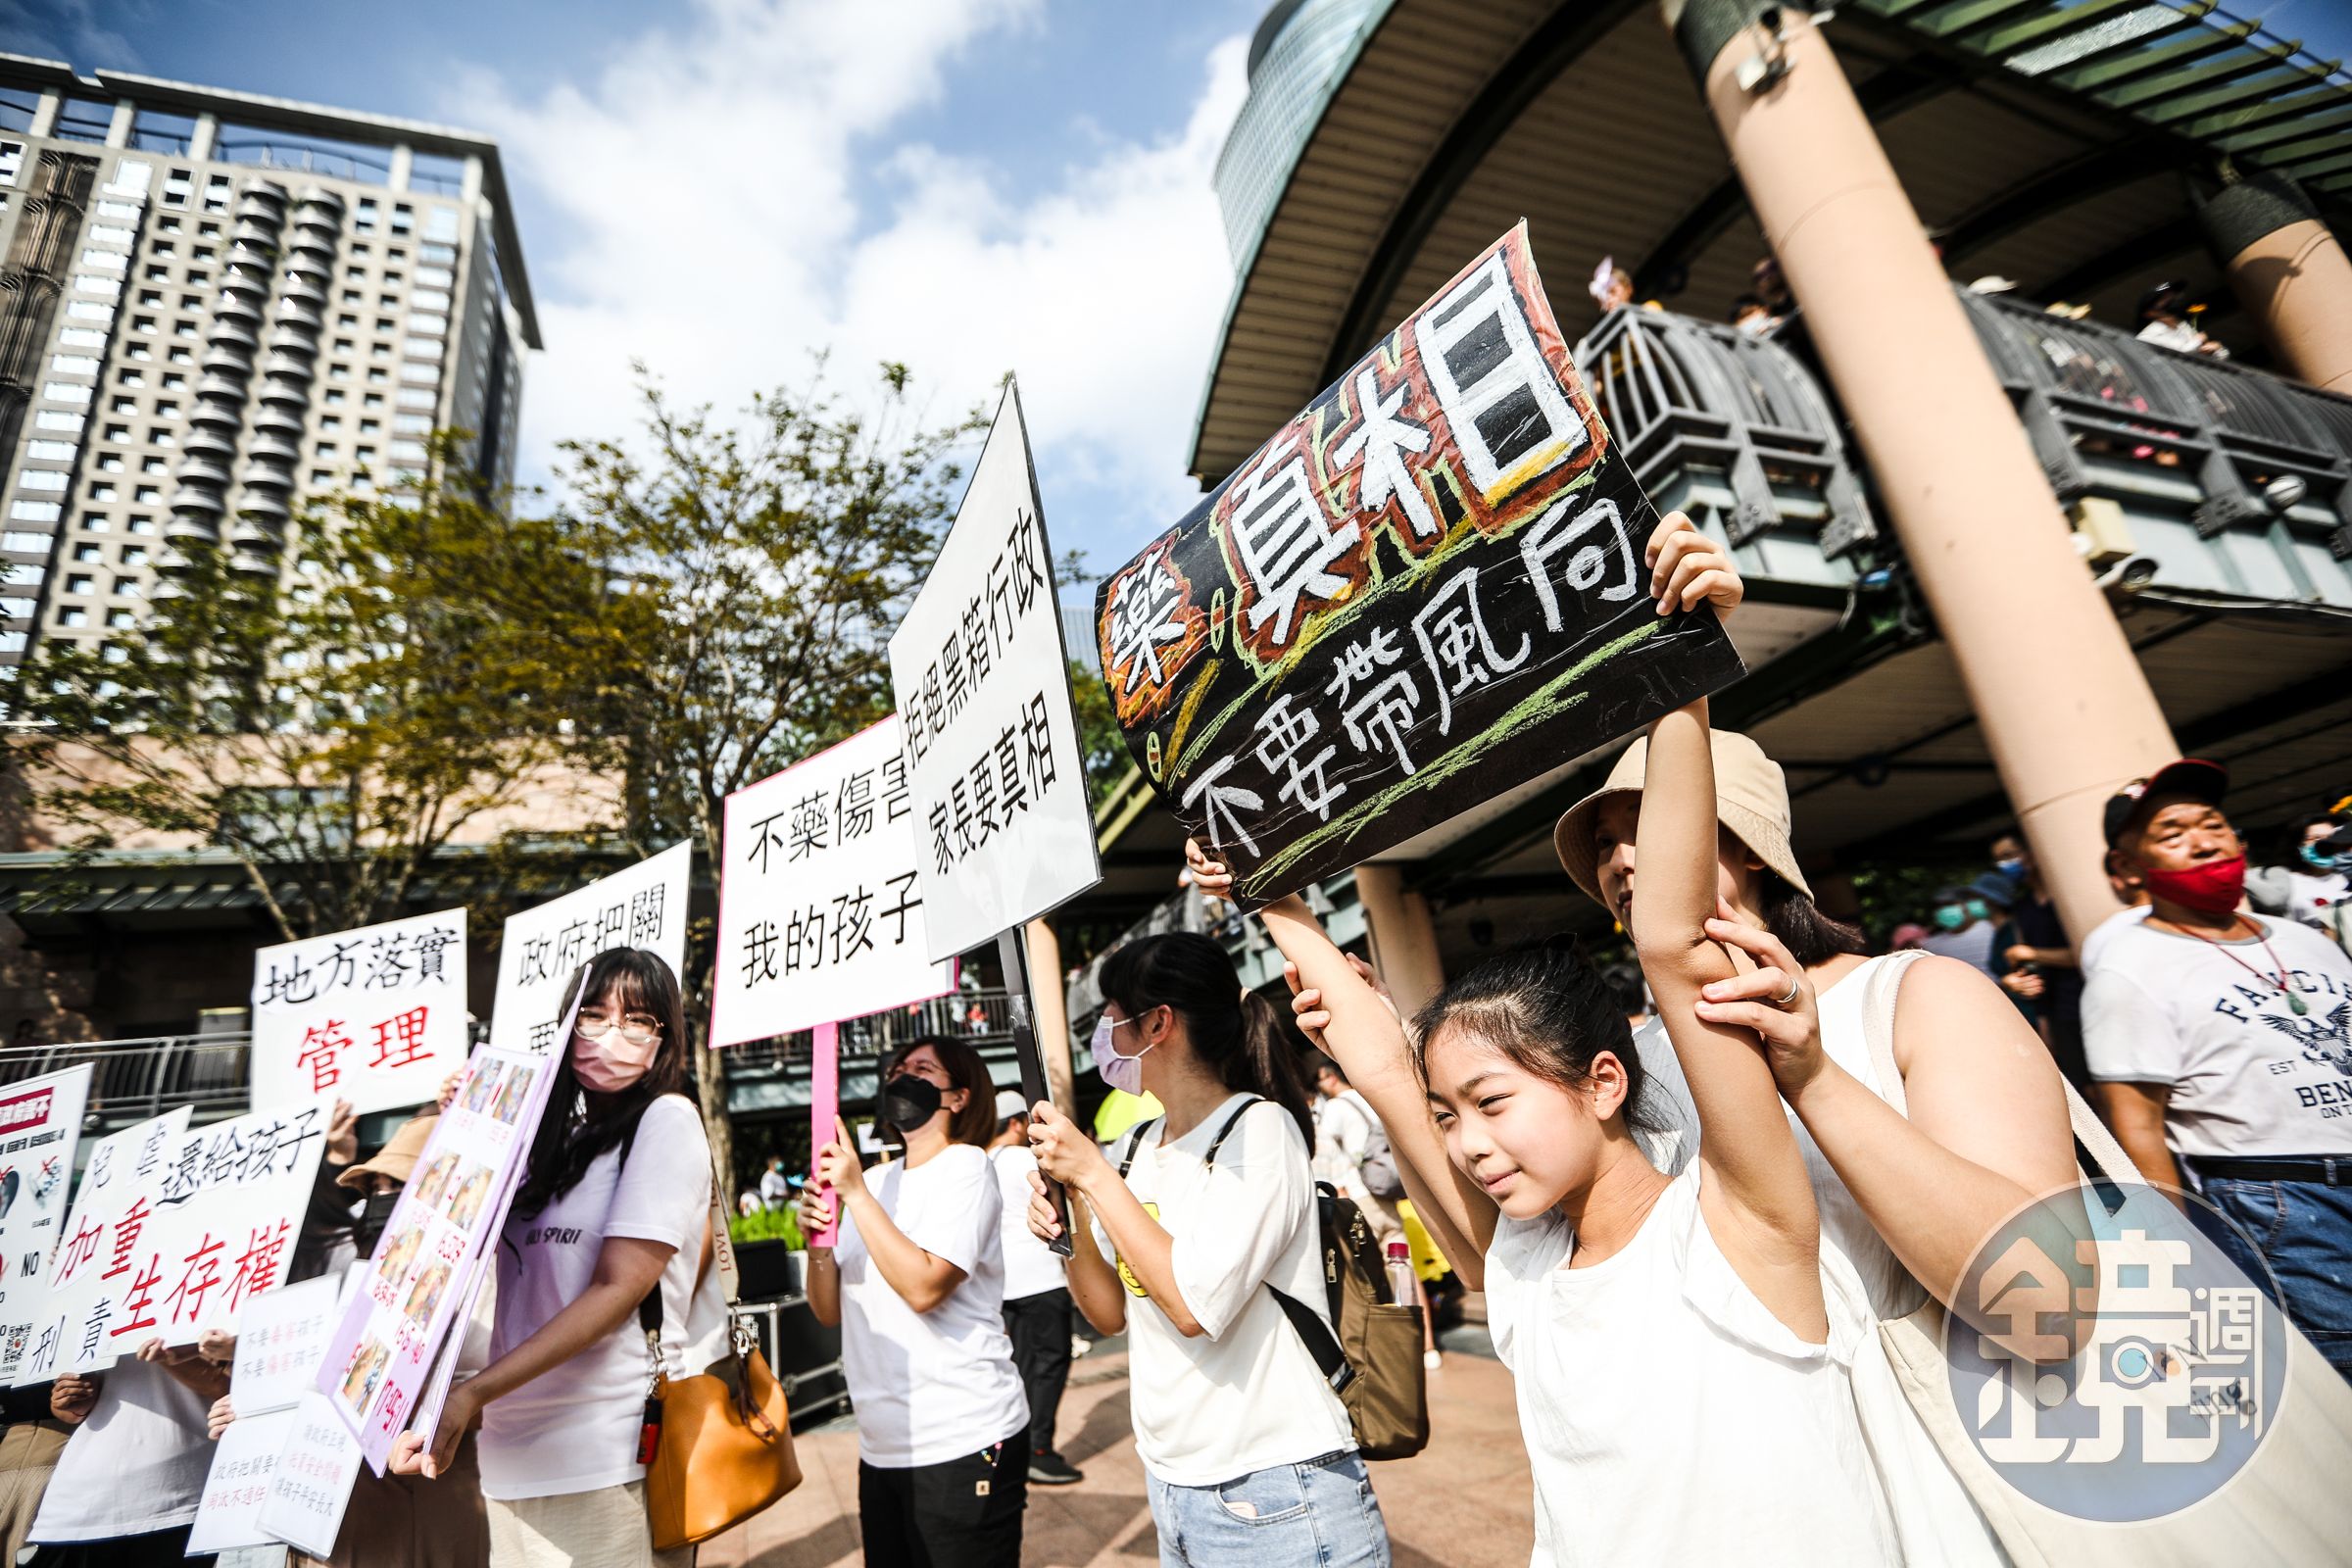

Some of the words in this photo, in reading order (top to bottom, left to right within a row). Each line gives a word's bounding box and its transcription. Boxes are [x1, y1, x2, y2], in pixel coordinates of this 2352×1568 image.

[905, 507, 1043, 769] 拒絕黑箱行政
[1183, 495, 1636, 858] 不要帶風向
[748, 748, 911, 874] 不藥傷害
[929, 690, 1055, 875] 家長要真相
[260, 927, 460, 1005] 地方落實
[517, 882, 664, 986] 政府把關
[742, 869, 922, 989] 我的孩子
[297, 1006, 435, 1094] 管理
[2269, 1059, 2298, 1075] EST
[156, 1107, 322, 1206] 還給孩子
[21, 1250, 39, 1278] NO
[53, 1197, 151, 1287] 加重
[110, 1217, 291, 1337] 生存權
[715, 1229, 731, 1271] LOVE
[28, 1297, 112, 1376] 刑責
